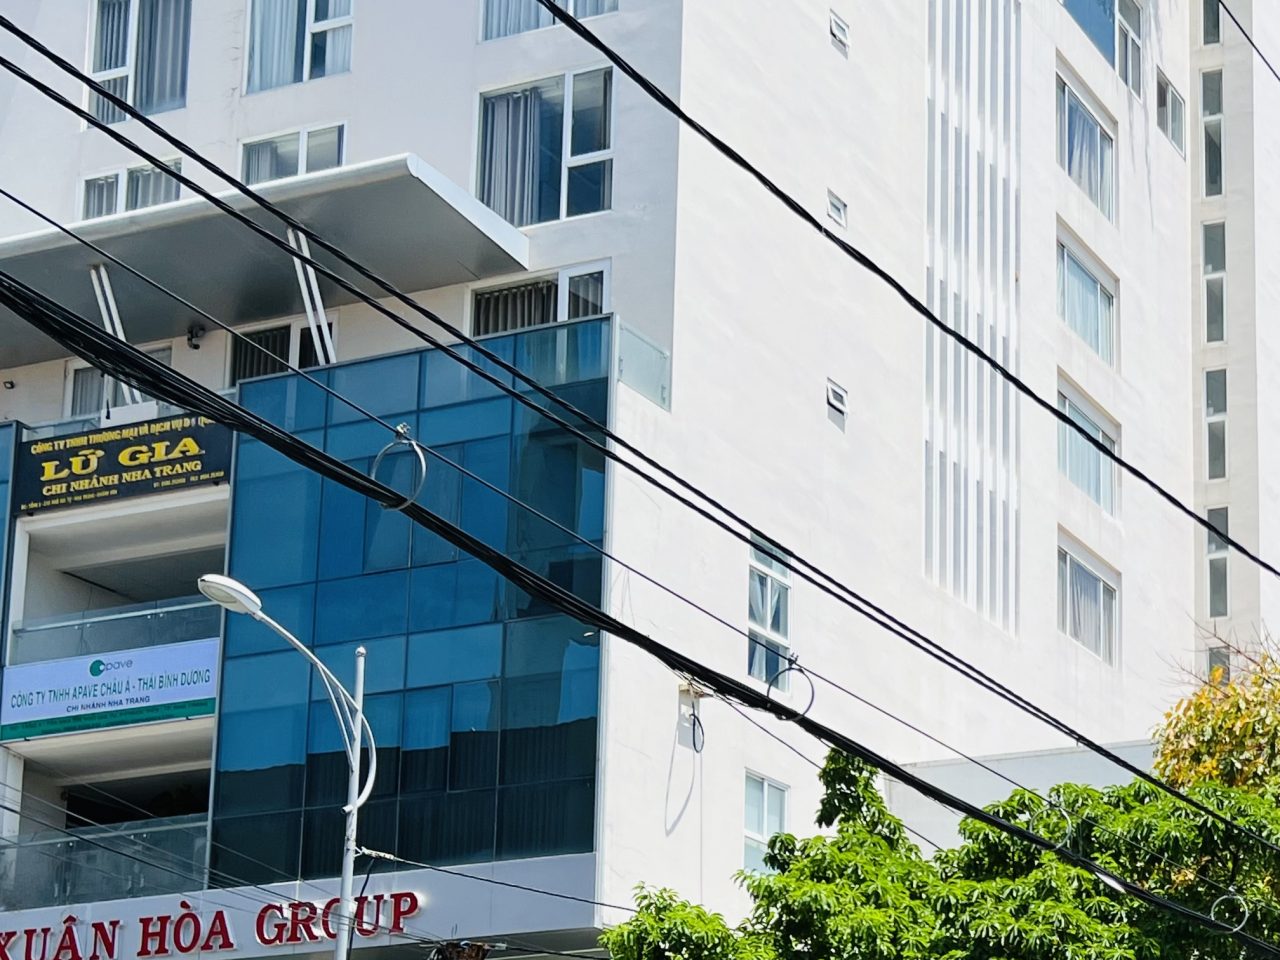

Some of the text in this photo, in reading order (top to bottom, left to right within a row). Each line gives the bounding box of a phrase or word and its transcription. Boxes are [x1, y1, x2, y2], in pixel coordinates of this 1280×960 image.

[118, 437, 206, 466] GIA
[43, 483, 68, 496] CHI
[122, 469, 152, 483] NHA
[154, 461, 202, 477] TRANG
[36, 690, 47, 704] TY
[48, 687, 71, 702] TNHH
[72, 683, 99, 700] APAVE
[138, 672, 157, 691] THÁI
[159, 669, 179, 689] BÌNH
[181, 668, 211, 686] DƯƠNG
[66, 705, 79, 713] CHI
[108, 698, 123, 707] NHA
[126, 695, 151, 705] TRANG
[137, 900, 235, 957] HÒA
